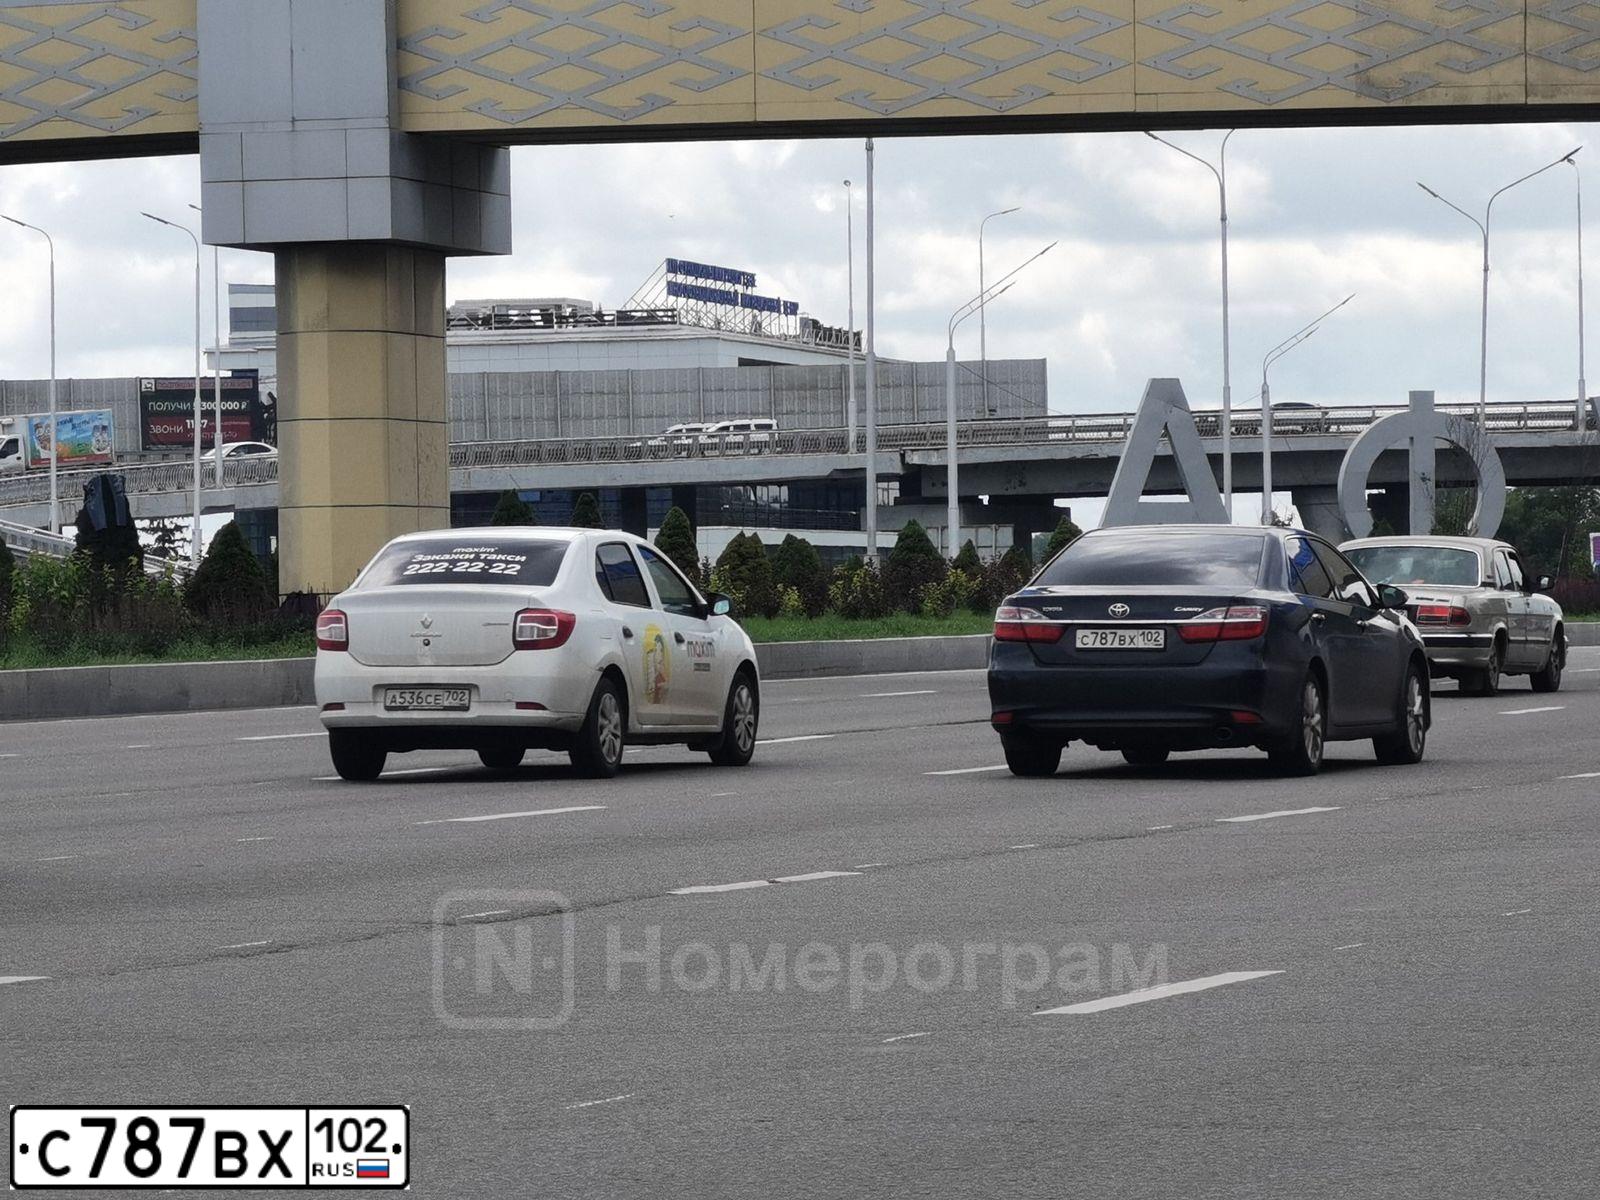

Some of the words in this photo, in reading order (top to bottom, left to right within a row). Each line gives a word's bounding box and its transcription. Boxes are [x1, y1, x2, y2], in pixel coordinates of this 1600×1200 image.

[148, 401, 191, 411] ПОЛУЧИ
[149, 424, 184, 434] ЗВОНИ
[412, 553, 475, 562] Закажи
[1080, 631, 1137, 646] С787ВХ
[1140, 631, 1161, 642] 102
[390, 691, 442, 705] А536СЕ
[445, 690, 467, 702] 702
